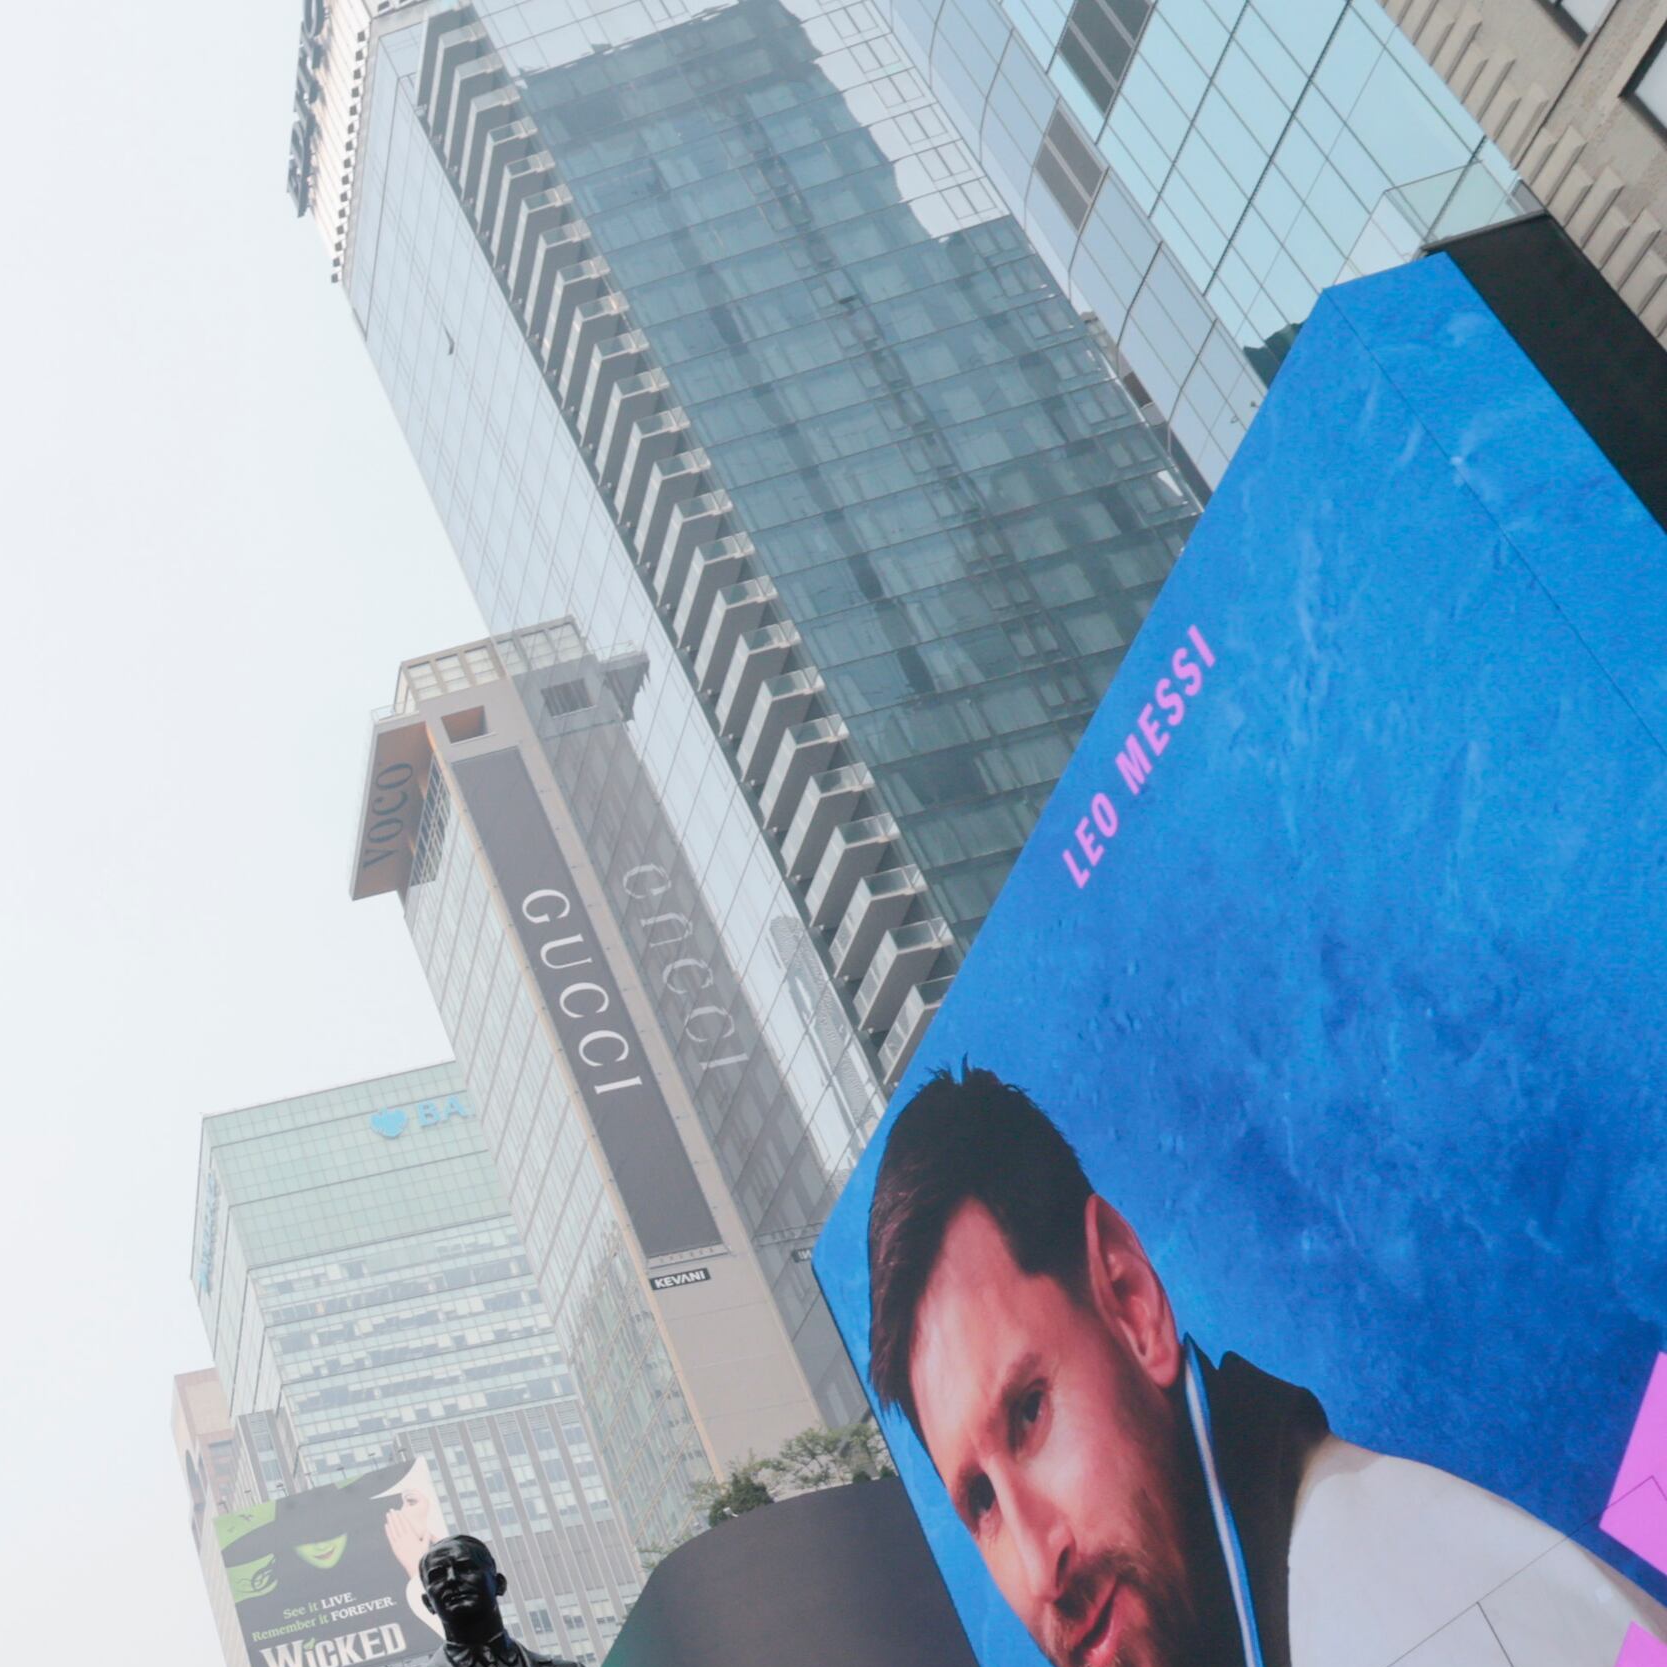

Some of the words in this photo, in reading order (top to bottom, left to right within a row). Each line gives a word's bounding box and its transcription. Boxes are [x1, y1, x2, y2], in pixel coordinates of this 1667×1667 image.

[1062, 792, 1119, 889] LEO
[1115, 623, 1216, 796] MESSI
[522, 888, 643, 1094] GUCCI
[653, 1269, 706, 1289] KEVANI
[283, 1606, 307, 1620] See
[309, 1601, 318, 1615] it
[252, 1617, 317, 1643] Remember
[318, 1614, 330, 1626] it
